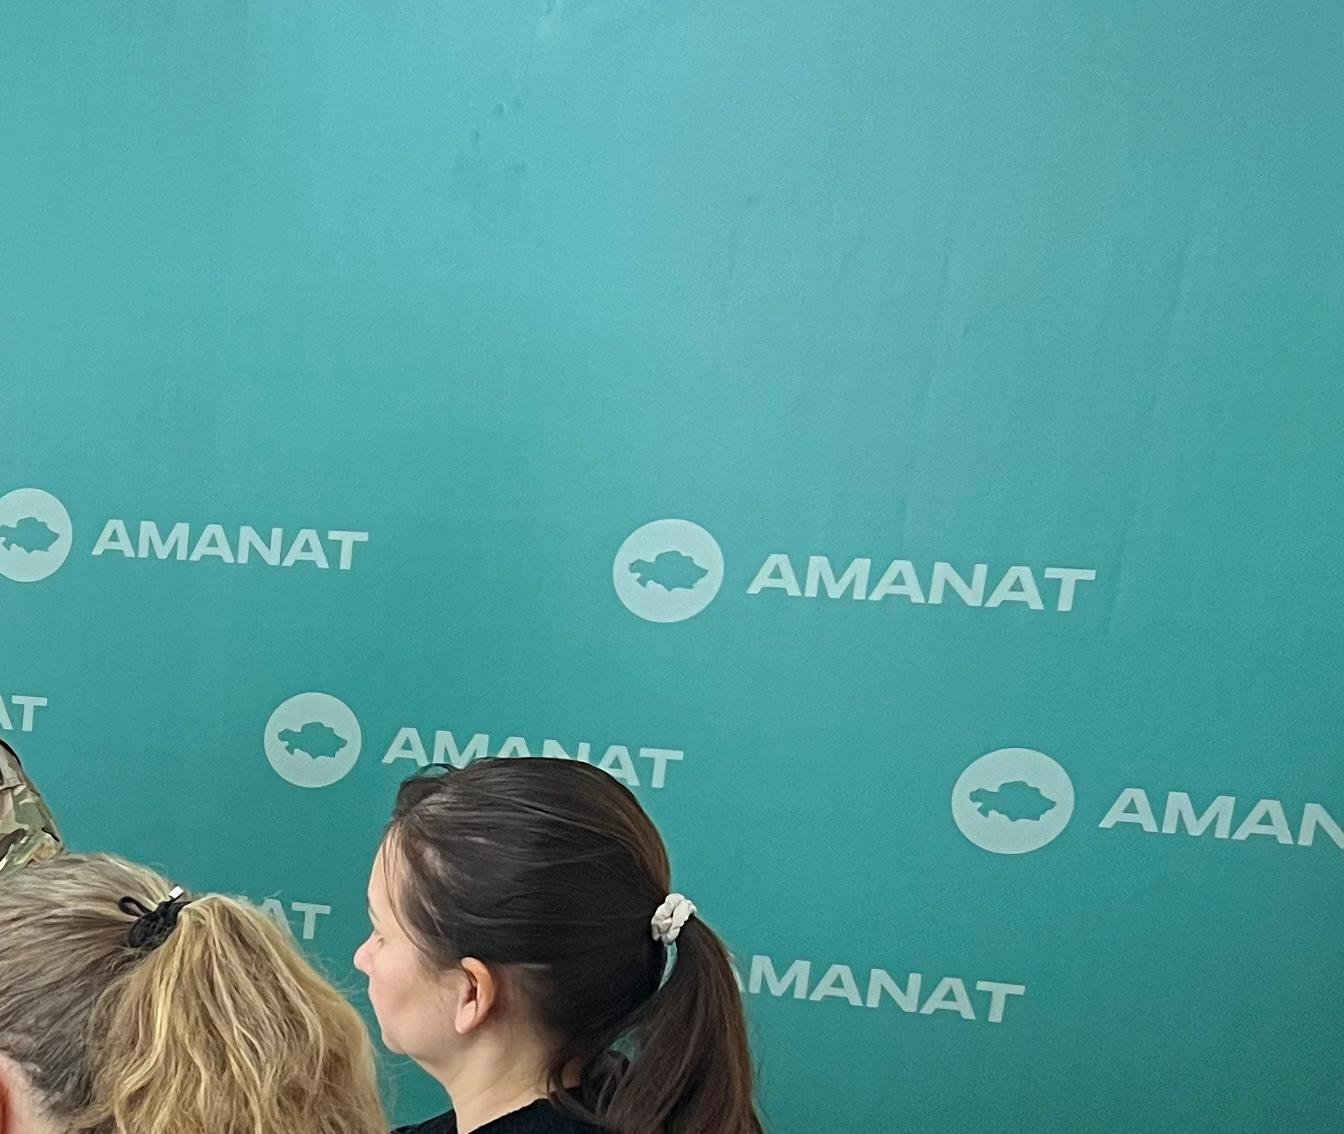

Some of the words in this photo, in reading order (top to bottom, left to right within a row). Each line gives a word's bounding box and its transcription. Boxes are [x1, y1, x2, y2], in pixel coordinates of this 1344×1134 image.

[92, 518, 369, 570] AMANAT
[746, 553, 1097, 612] AMANAT
[1097, 787, 1344, 850] AMAN
[730, 954, 1026, 1023] MANAT
